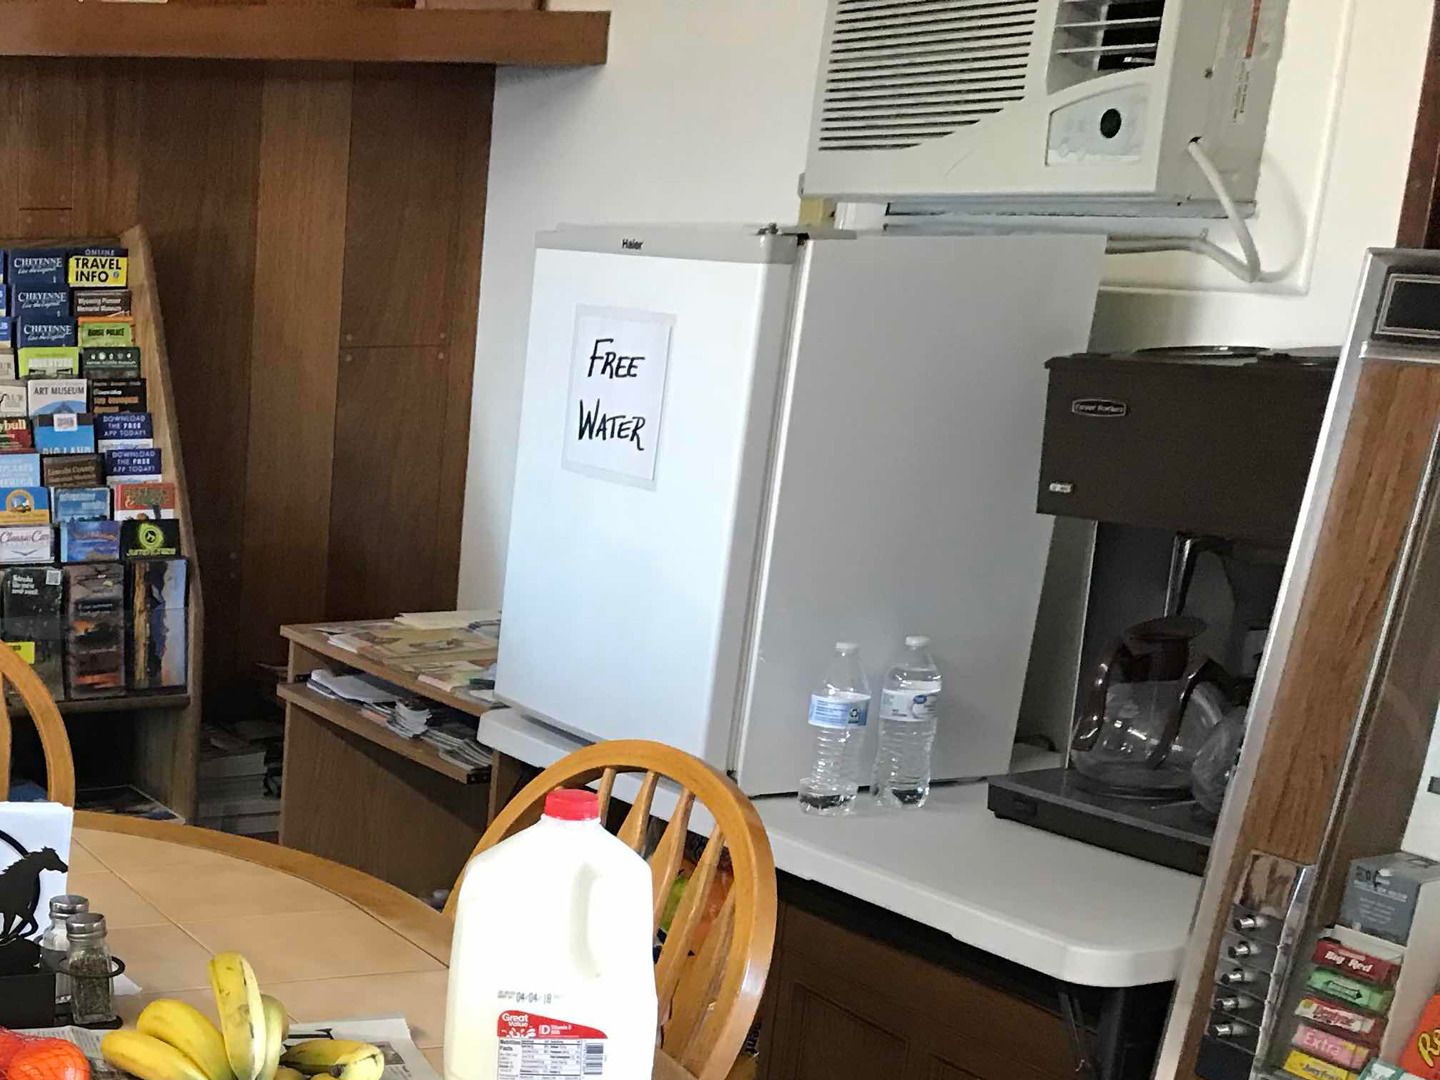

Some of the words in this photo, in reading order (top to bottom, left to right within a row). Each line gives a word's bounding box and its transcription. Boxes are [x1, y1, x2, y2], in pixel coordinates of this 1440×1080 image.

[14, 257, 63, 268] CHEYENNE
[74, 257, 122, 270] TRAVEL
[75, 270, 109, 283] INFO
[18, 291, 67, 302] CHEYENNE
[23, 325, 73, 335] CHEYENNE
[587, 338, 645, 379] FREE
[33, 387, 49, 395] ART
[50, 387, 85, 396] MUSEUM
[103, 415, 146, 423] DOWNLOAD
[578, 398, 646, 451] WATER
[112, 450, 155, 458] DOWNLOAD
[1324, 950, 1345, 965] Big
[1348, 957, 1374, 973] Red
[501, 1012, 529, 1023] Great
[508, 1020, 529, 1028] Value
[1303, 1032, 1340, 1057] Extra
